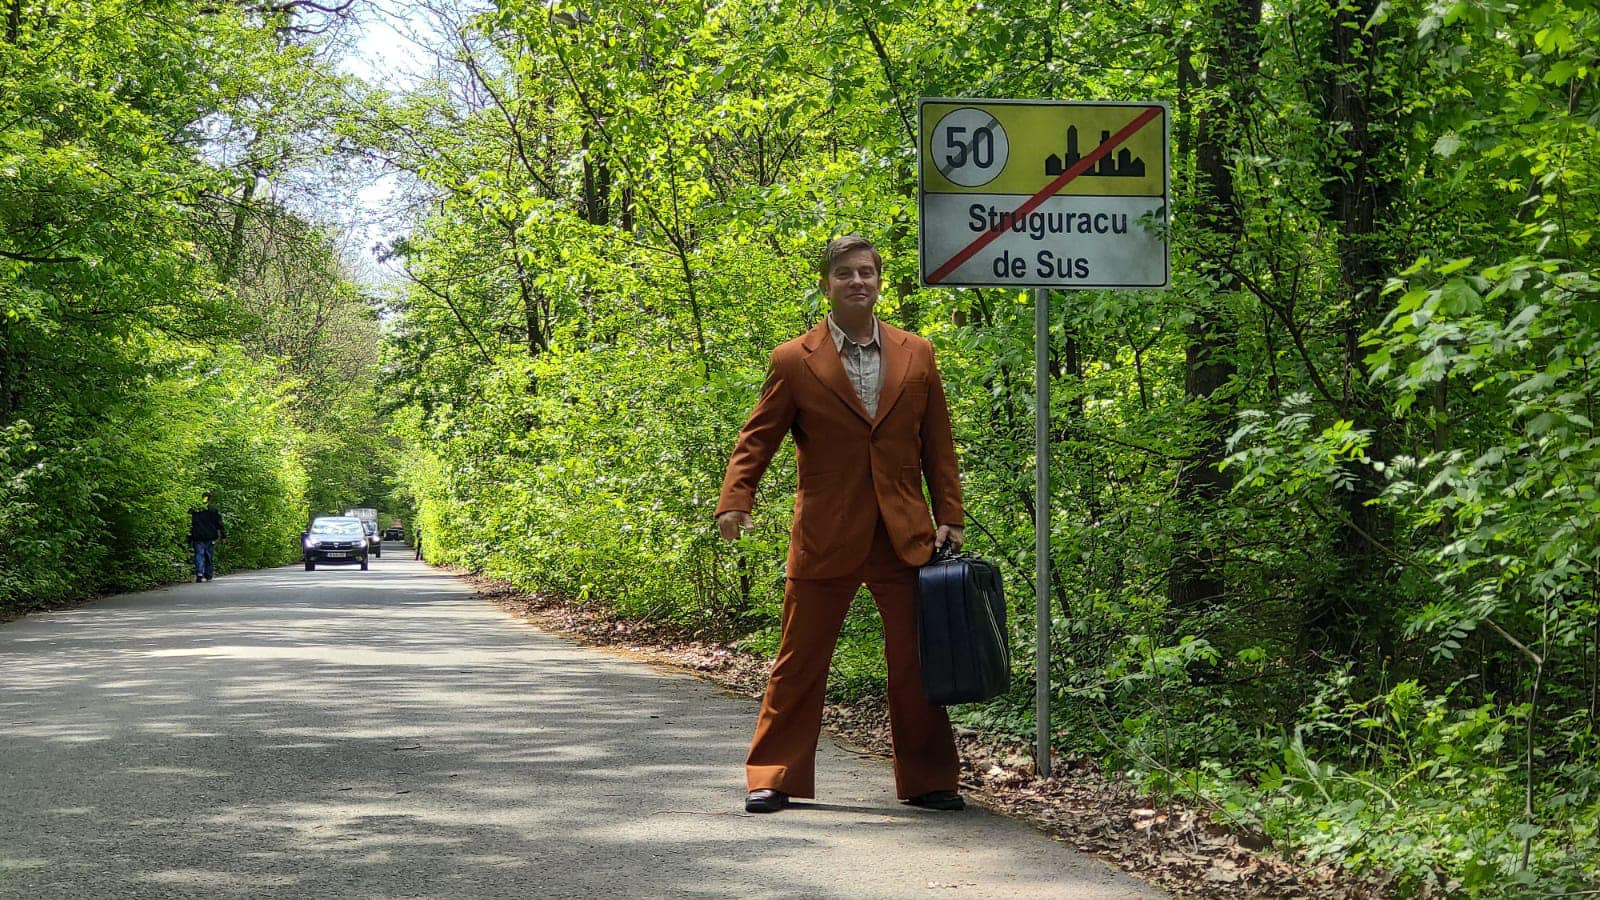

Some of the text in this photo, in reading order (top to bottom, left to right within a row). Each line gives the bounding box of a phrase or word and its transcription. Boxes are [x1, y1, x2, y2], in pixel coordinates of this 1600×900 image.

[946, 127, 994, 169] 50
[968, 204, 1127, 240] Struguracu
[993, 250, 1090, 279] de Sus
